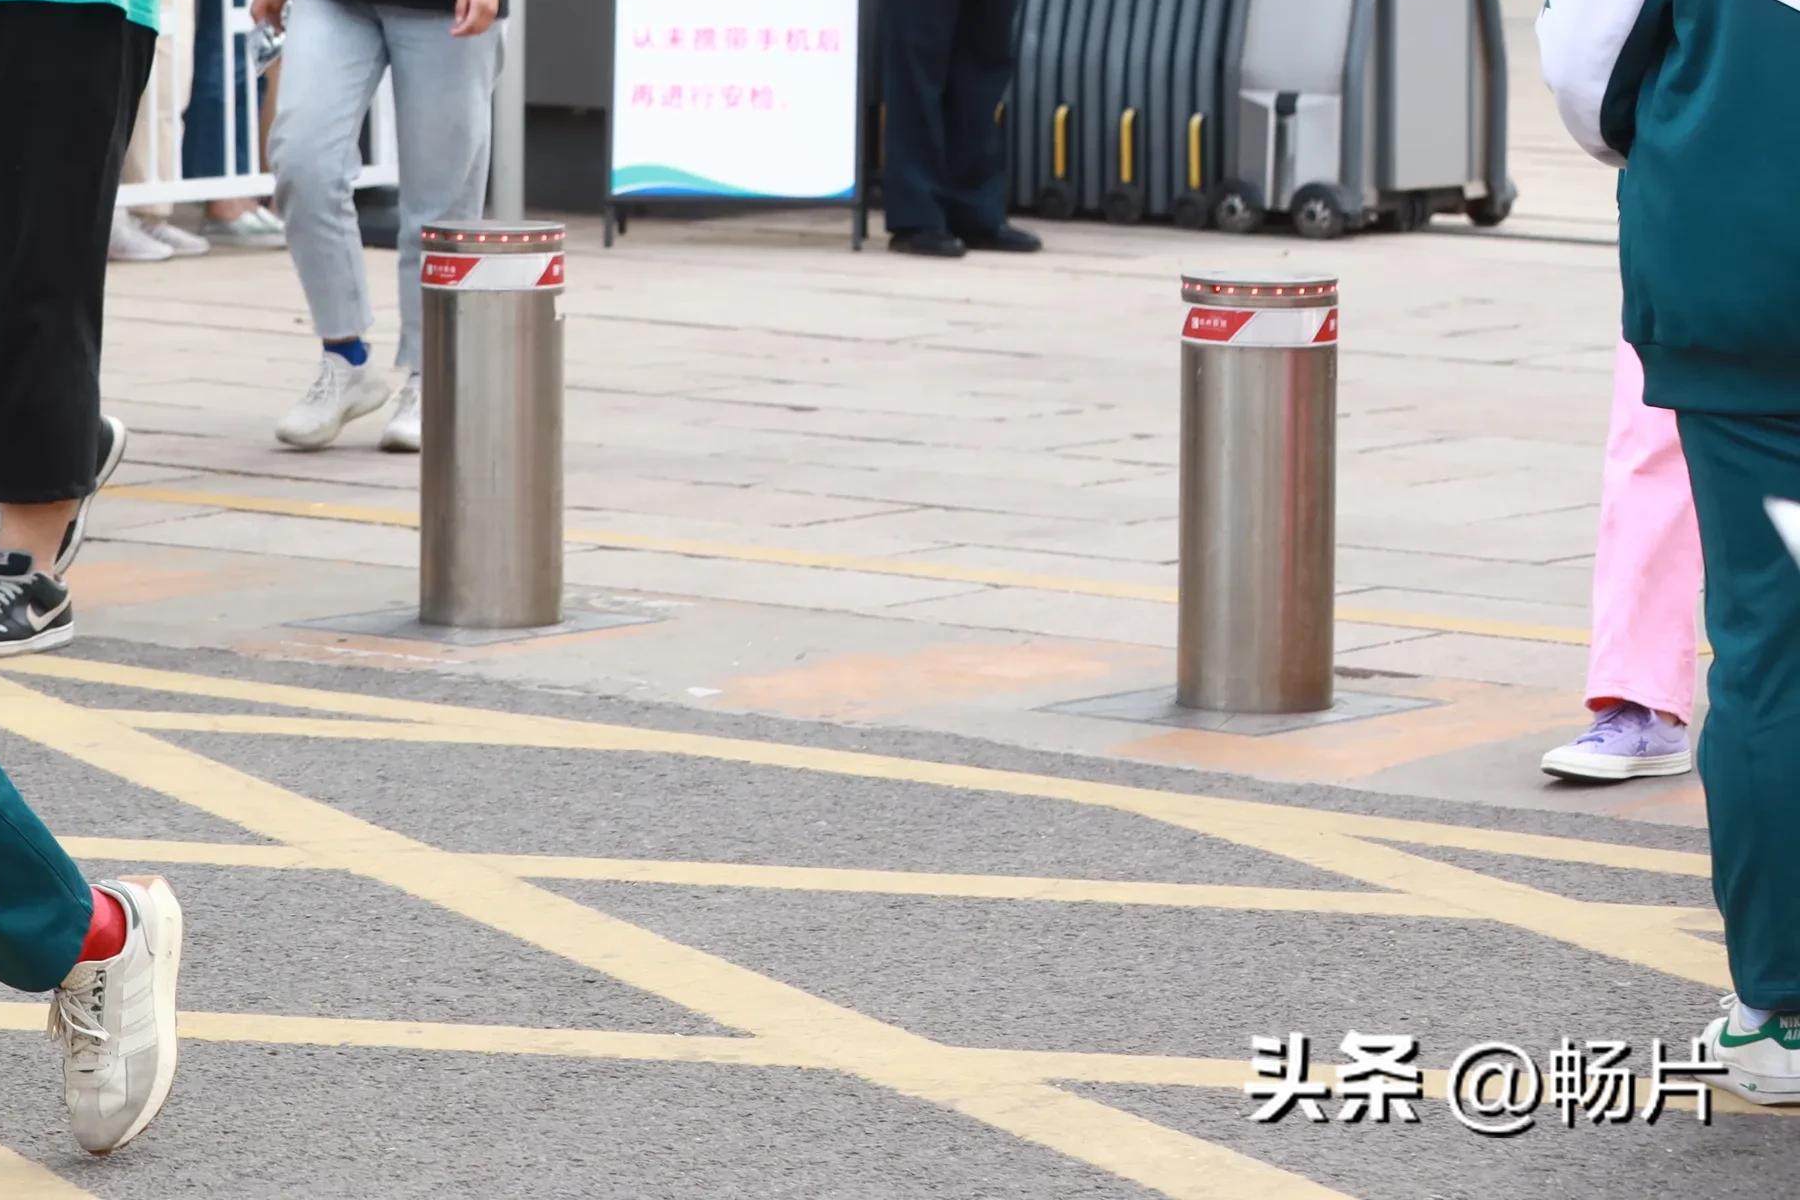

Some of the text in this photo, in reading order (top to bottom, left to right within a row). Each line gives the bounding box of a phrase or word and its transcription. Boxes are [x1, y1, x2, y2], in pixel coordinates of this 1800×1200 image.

[632, 26, 841, 52] 认未携带手机后
